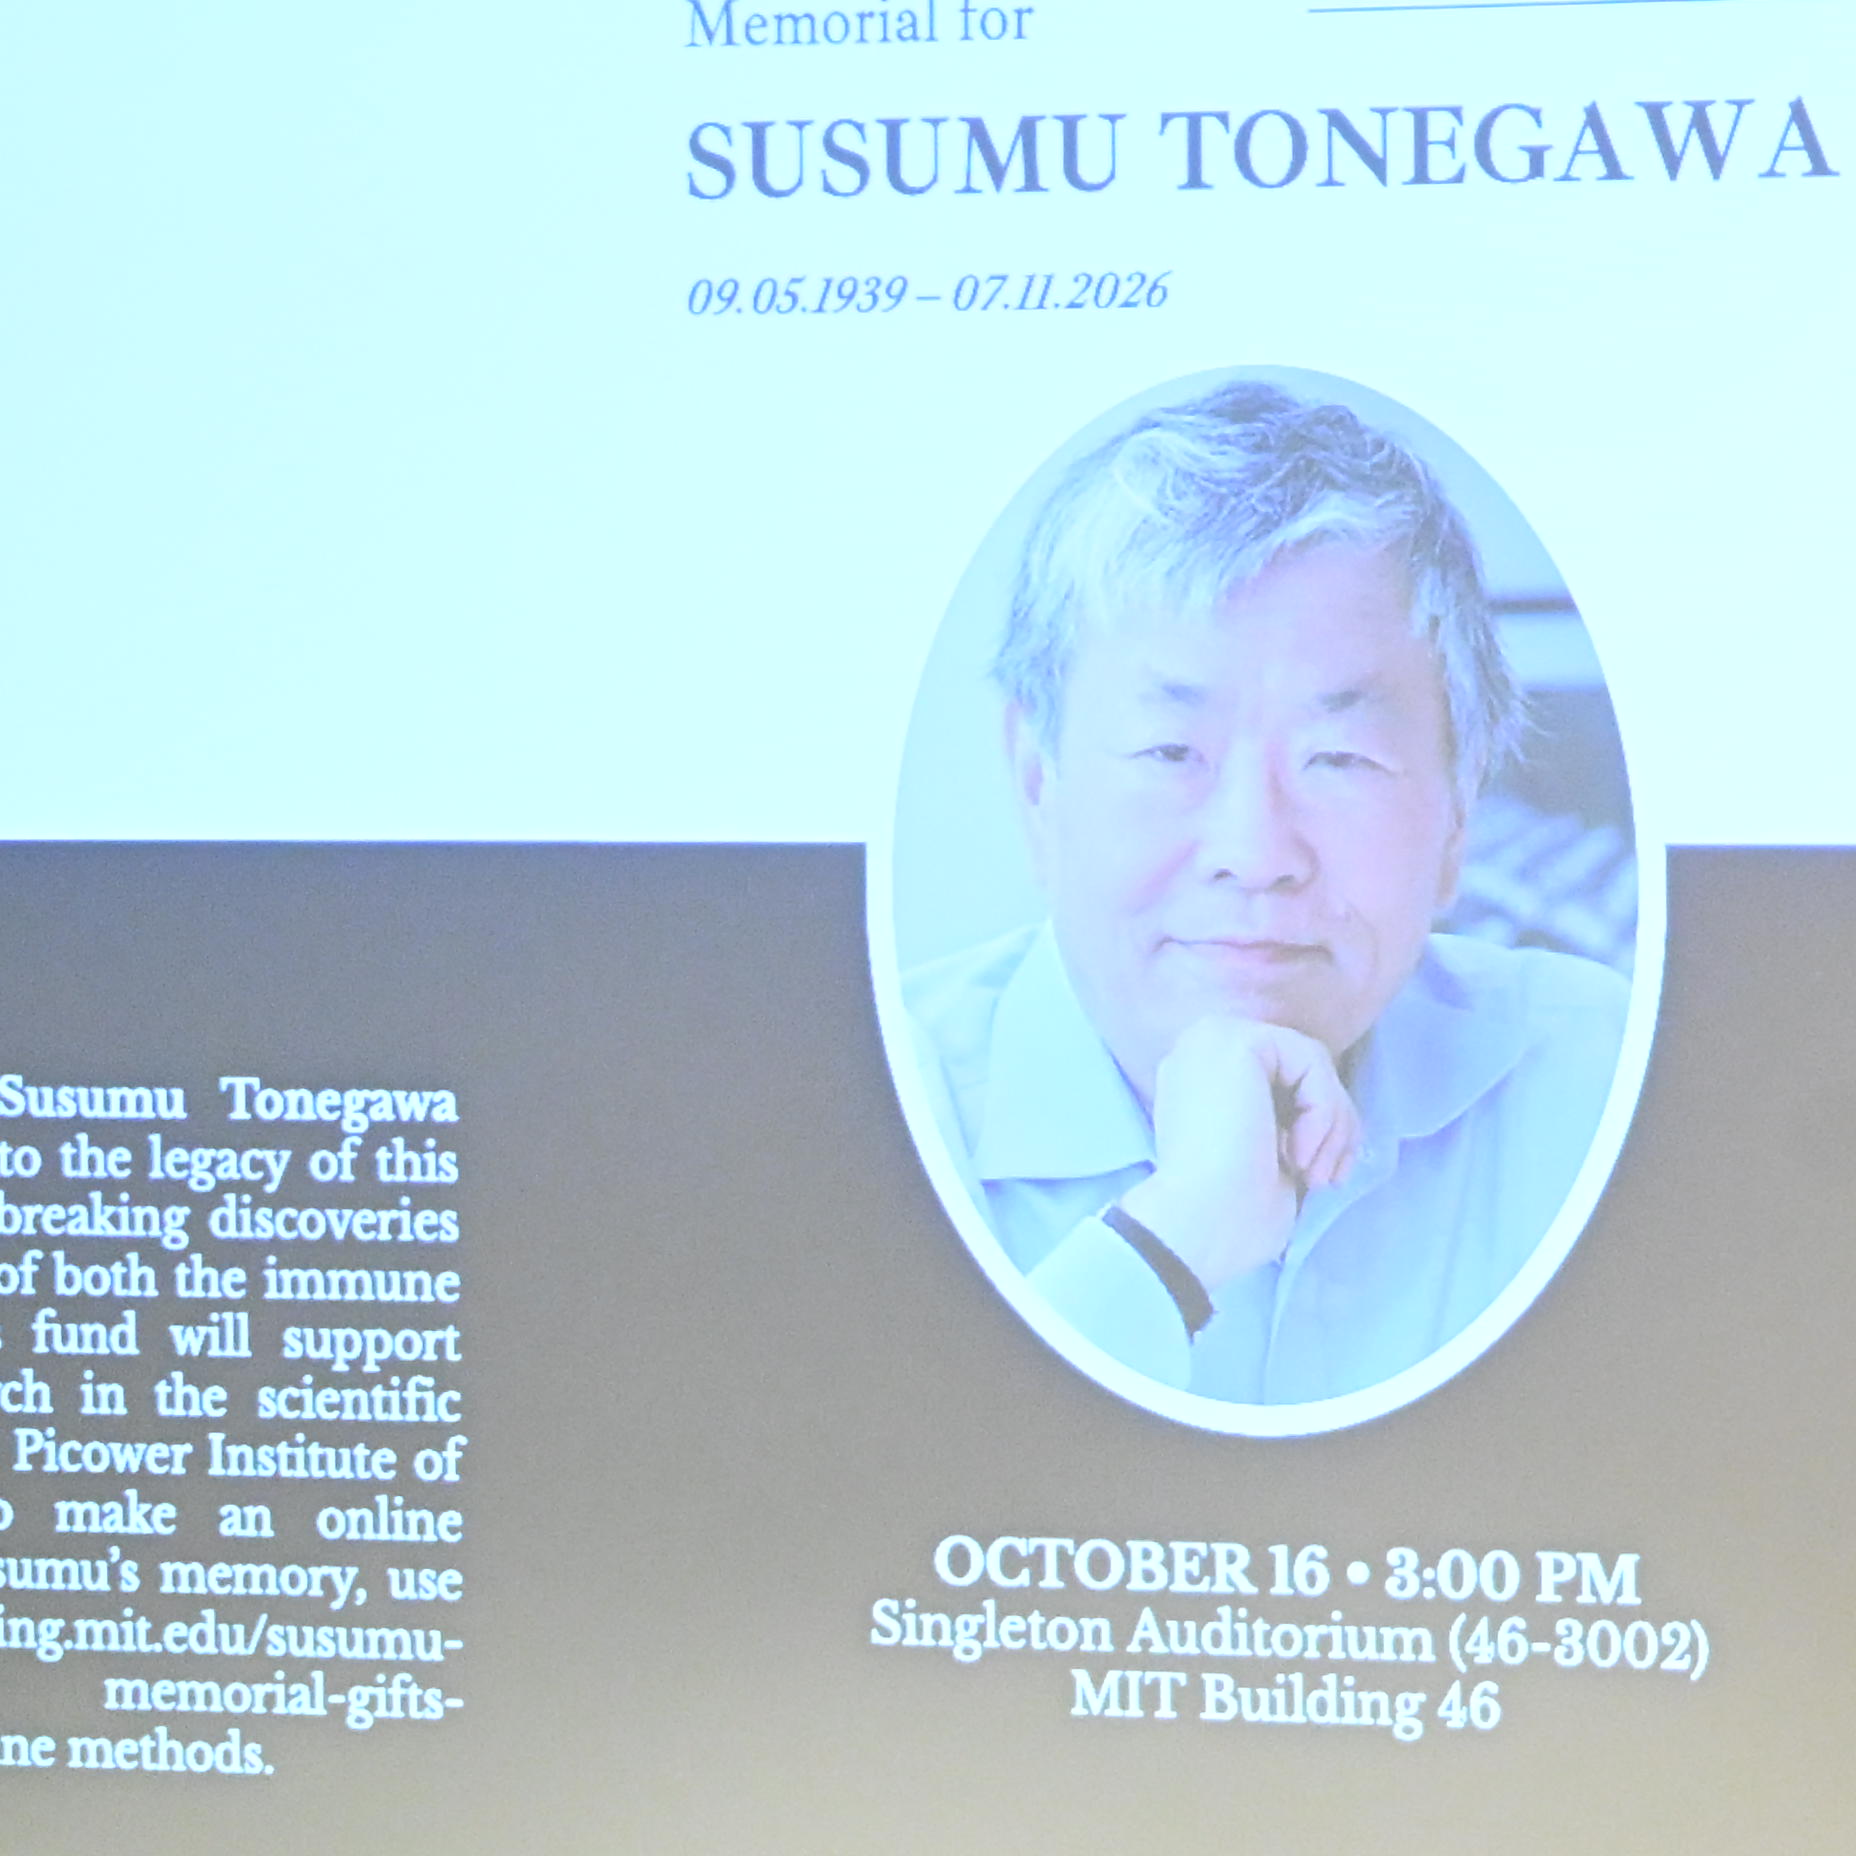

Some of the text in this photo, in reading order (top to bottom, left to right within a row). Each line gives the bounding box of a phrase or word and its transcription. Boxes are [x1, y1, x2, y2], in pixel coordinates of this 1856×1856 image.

[686, 0, 1034, 47] Memorial for
[687, 96, 1840, 200] SUSUMU TONEGAWA
[688, 276, 908, 315] 09.05.1939
[953, 271, 1171, 311] 07.11.2026
[0, 1075, 459, 1133] Susumu Tonegawa
[0, 1133, 458, 1193] to the legacy of this
[210, 1193, 459, 1241] discoveries
[0, 1250, 460, 1302] of both the immune
[32, 1308, 139, 1355] fund
[169, 1312, 251, 1357] will
[284, 1325, 461, 1372] support
[0, 1369, 461, 1422] ch in the scientific
[13, 1427, 467, 1481] Picower Institute of
[55, 1489, 176, 1534] make
[220, 1505, 274, 1537] an
[317, 1495, 462, 1542] online
[160, 1562, 366, 1609] memory,
[387, 1568, 462, 1600] use
[934, 1535, 1258, 1594] OCTOBER
[1268, 1545, 1329, 1595] 16
[1385, 1547, 1519, 1601] 3:00
[1536, 1552, 1641, 1604] PM
[871, 1598, 1709, 1683] Singleton Auditorium (46-3002)
[104, 1670, 464, 1731] memorial-gifts-
[1070, 1669, 1501, 1741] MIT Building 46
[68, 1726, 274, 1775] methods.
